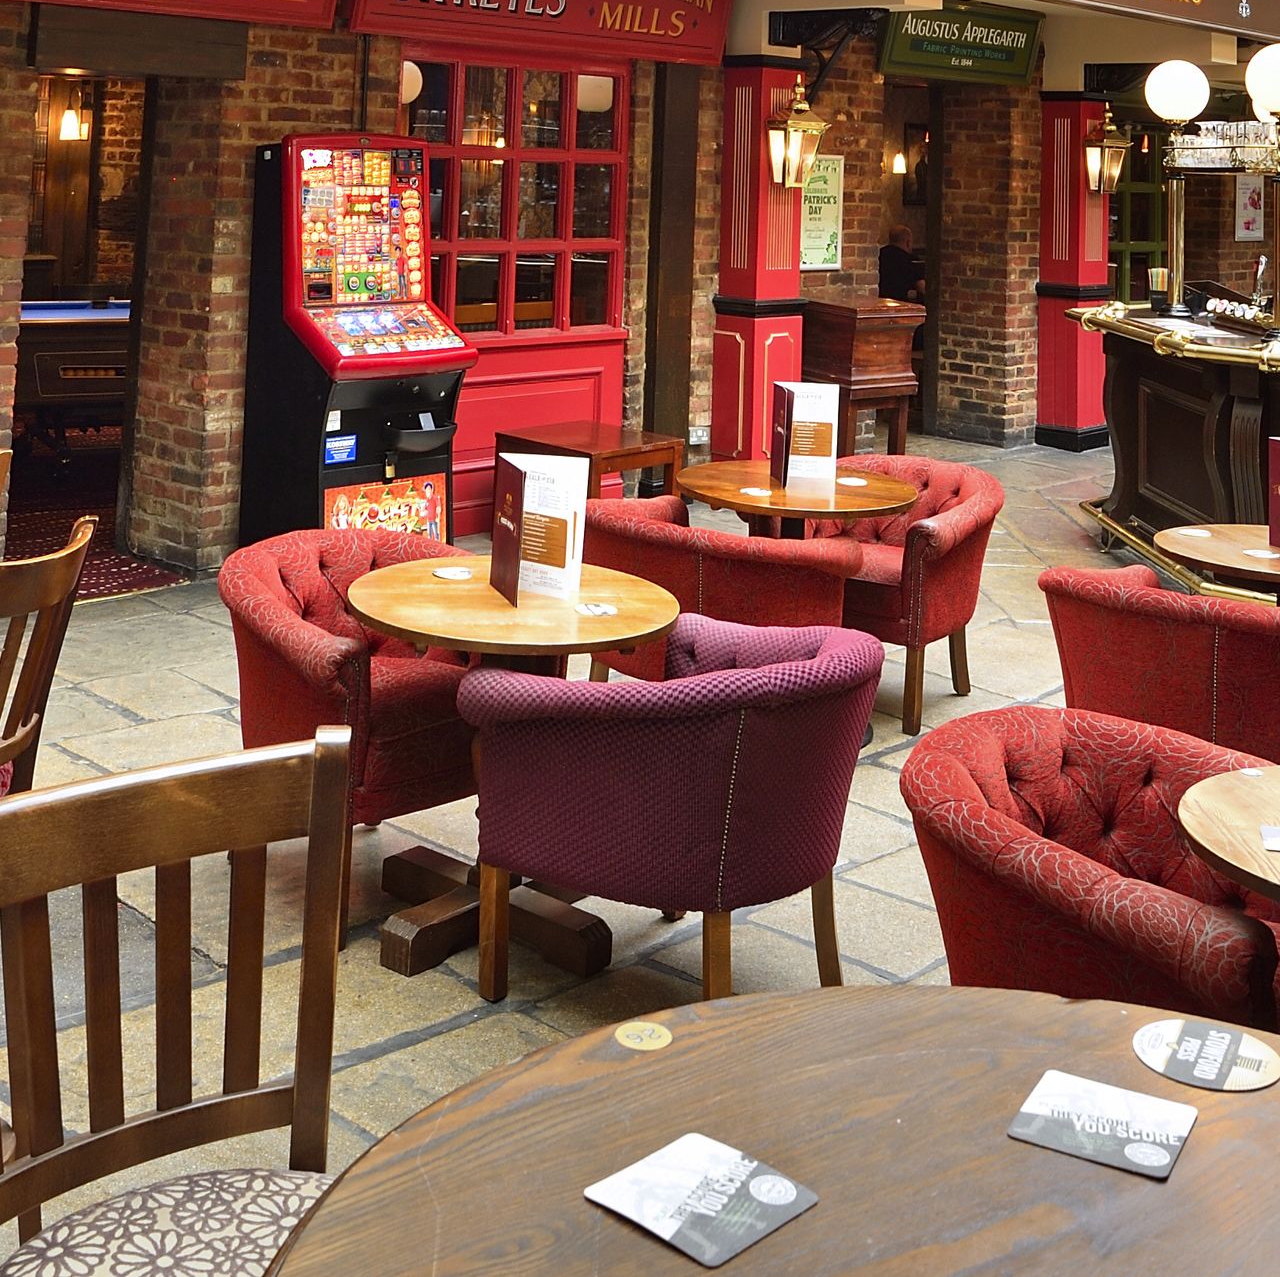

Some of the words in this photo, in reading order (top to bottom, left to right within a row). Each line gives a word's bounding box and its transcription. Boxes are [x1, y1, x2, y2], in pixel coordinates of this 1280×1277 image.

[598, 1, 687, 37] MILLS
[901, 12, 960, 40] AUGUSTUS
[961, 21, 1027, 49] APPLEGARTH
[922, 42, 947, 54] FABRIC
[950, 44, 983, 58] PRINTING
[984, 48, 1007, 60] WORKS
[809, 206, 822, 215] DAY
[1176, 1036, 1202, 1062] PRESS
[1193, 1030, 1232, 1080] STOWFORD
[1071, 1115, 1111, 1136] YOU
[1115, 1124, 1180, 1145] SCORE
